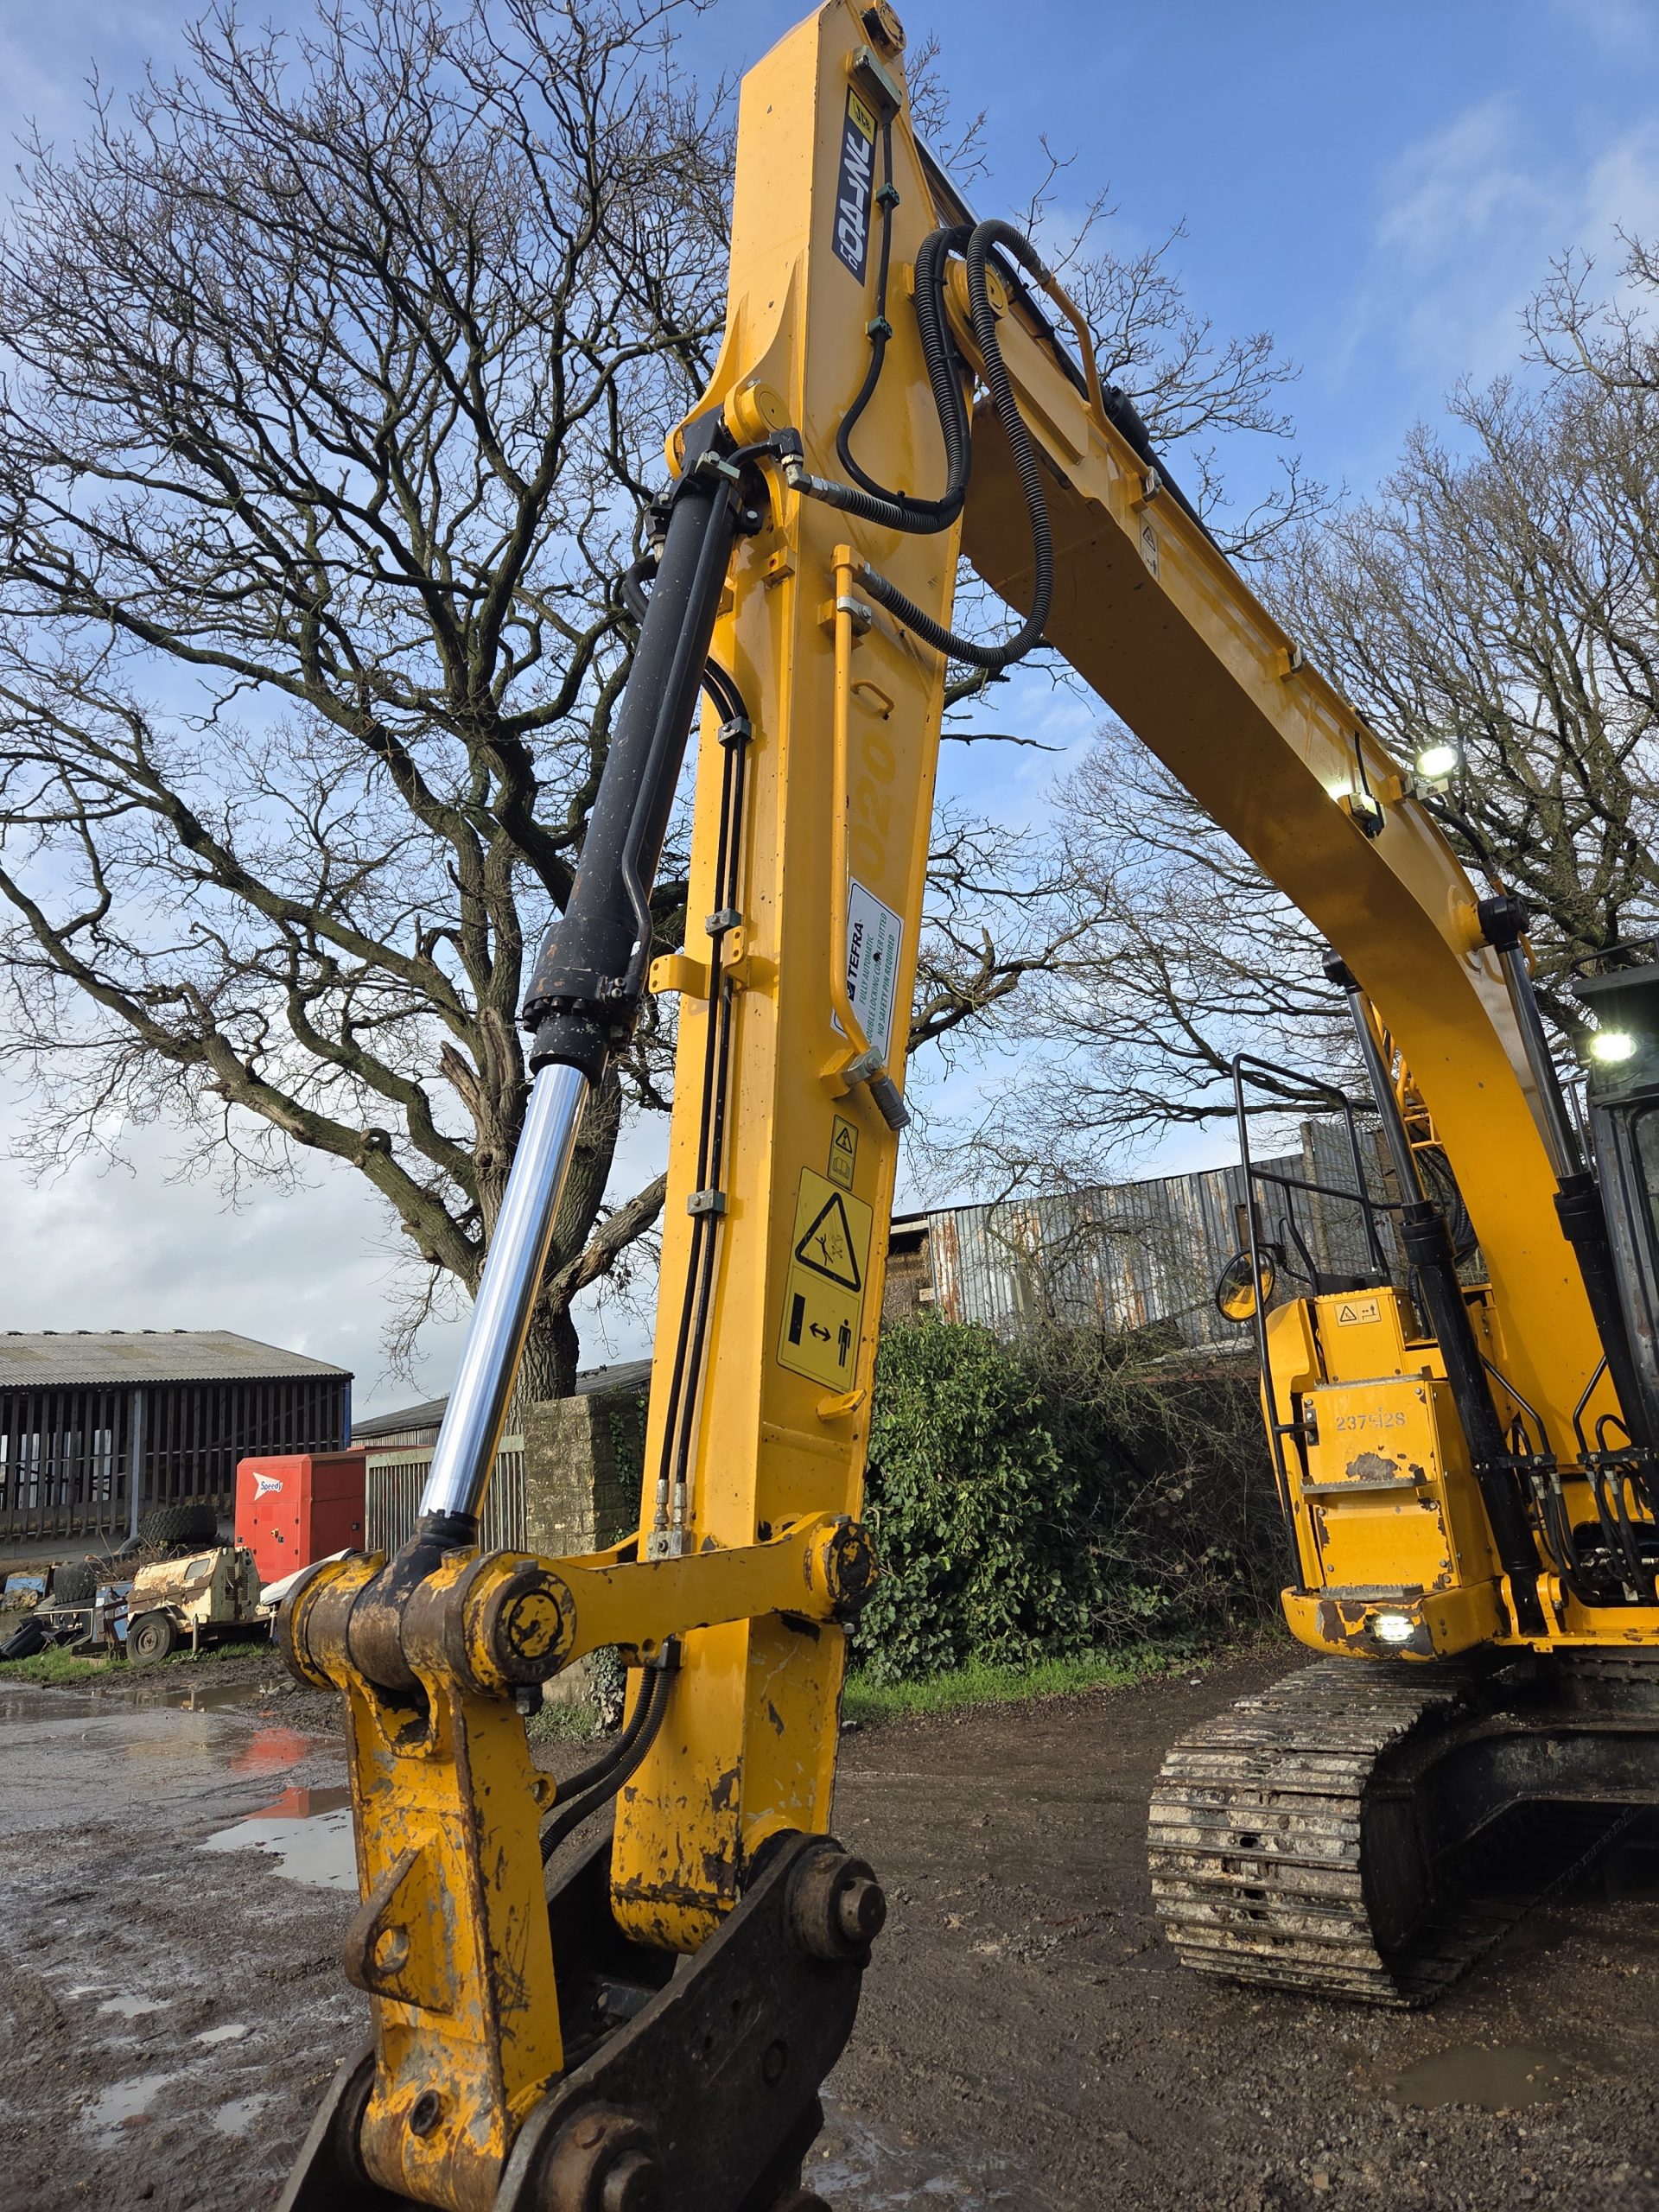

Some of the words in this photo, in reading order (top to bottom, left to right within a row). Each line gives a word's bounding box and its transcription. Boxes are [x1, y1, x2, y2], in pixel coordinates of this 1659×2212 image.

[878, 912, 887, 940] FITTED
[848, 922, 864, 978] TEFRA
[862, 933, 874, 981] AUTOMATIC
[873, 939, 884, 976] COULER
[885, 934, 895, 976] REQUIRED
[859, 978, 868, 1005] FULLY
[869, 975, 880, 1011] LOCKING
[879, 990, 888, 1024] SAFETY
[877, 1023, 885, 1037] NO
[261, 1481, 282, 1491] Speedy
